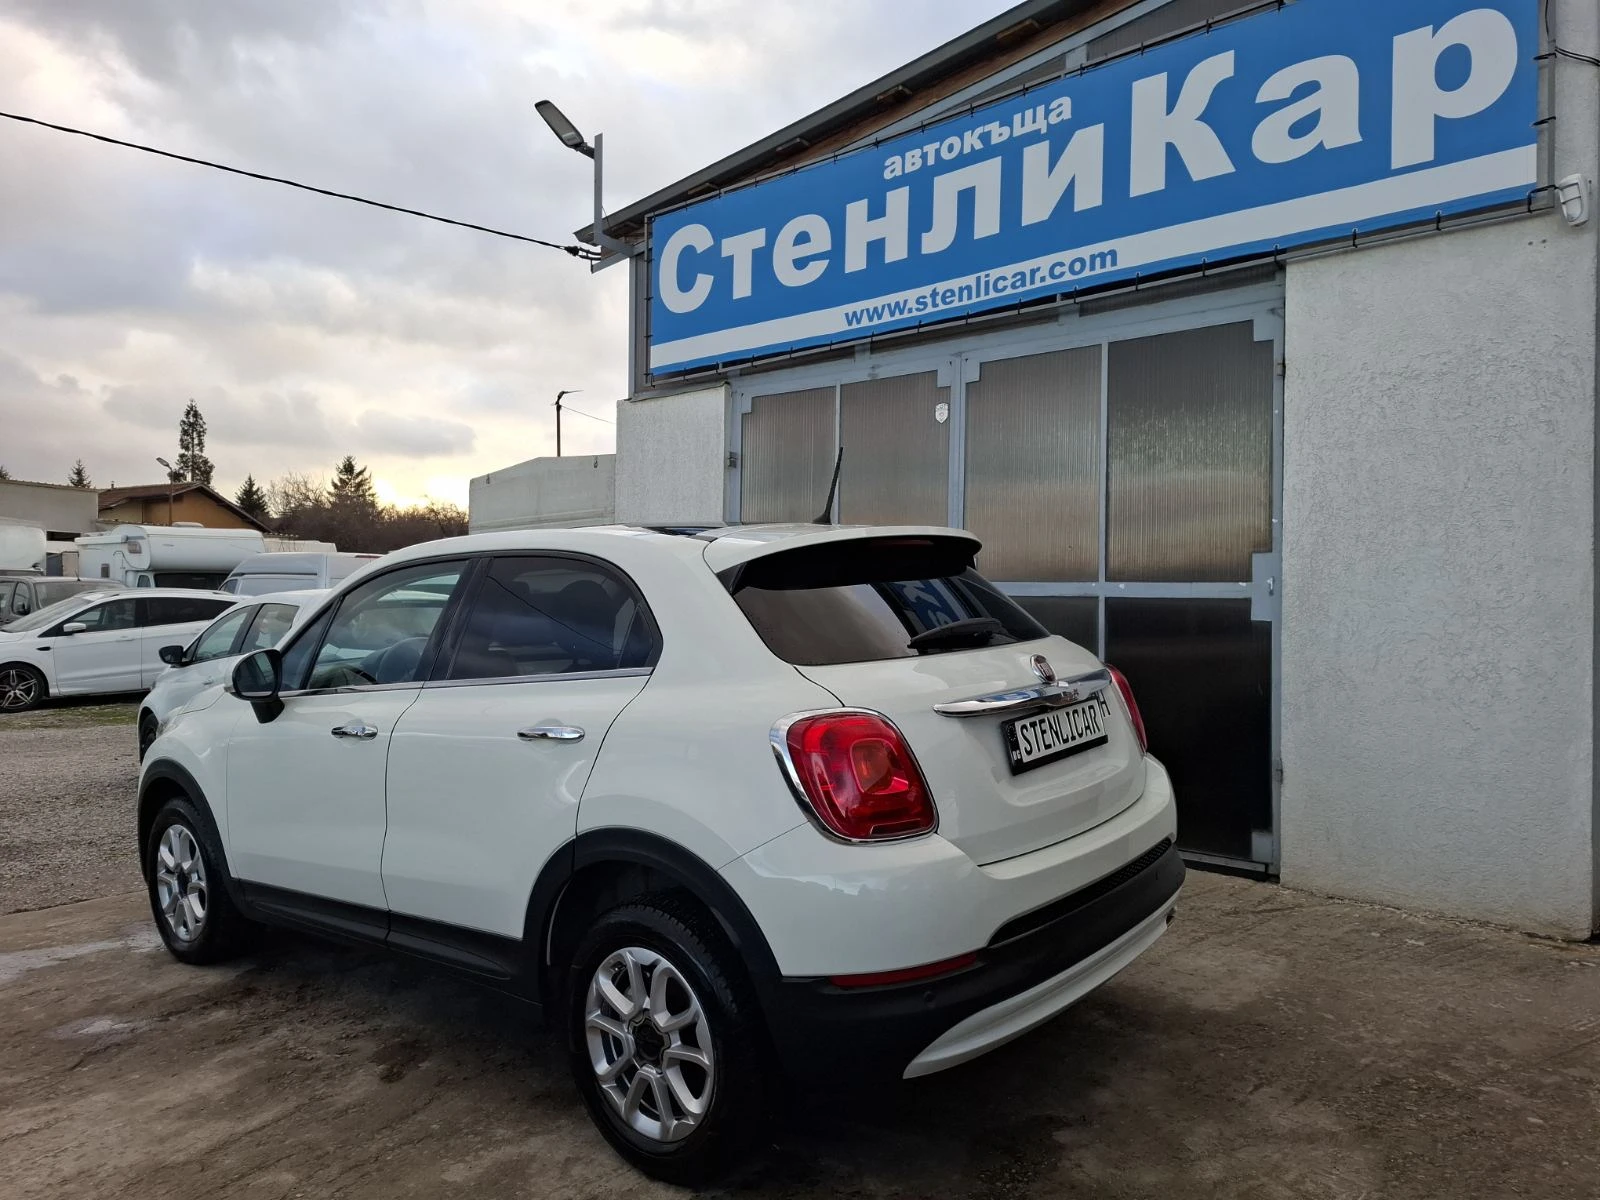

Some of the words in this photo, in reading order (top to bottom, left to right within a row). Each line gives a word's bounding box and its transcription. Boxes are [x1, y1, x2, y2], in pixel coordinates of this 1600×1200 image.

[883, 96, 1072, 180] автокъща
[844, 248, 1119, 327] www.stenlicar.com
[1020, 704, 1100, 756] STENLICAR
